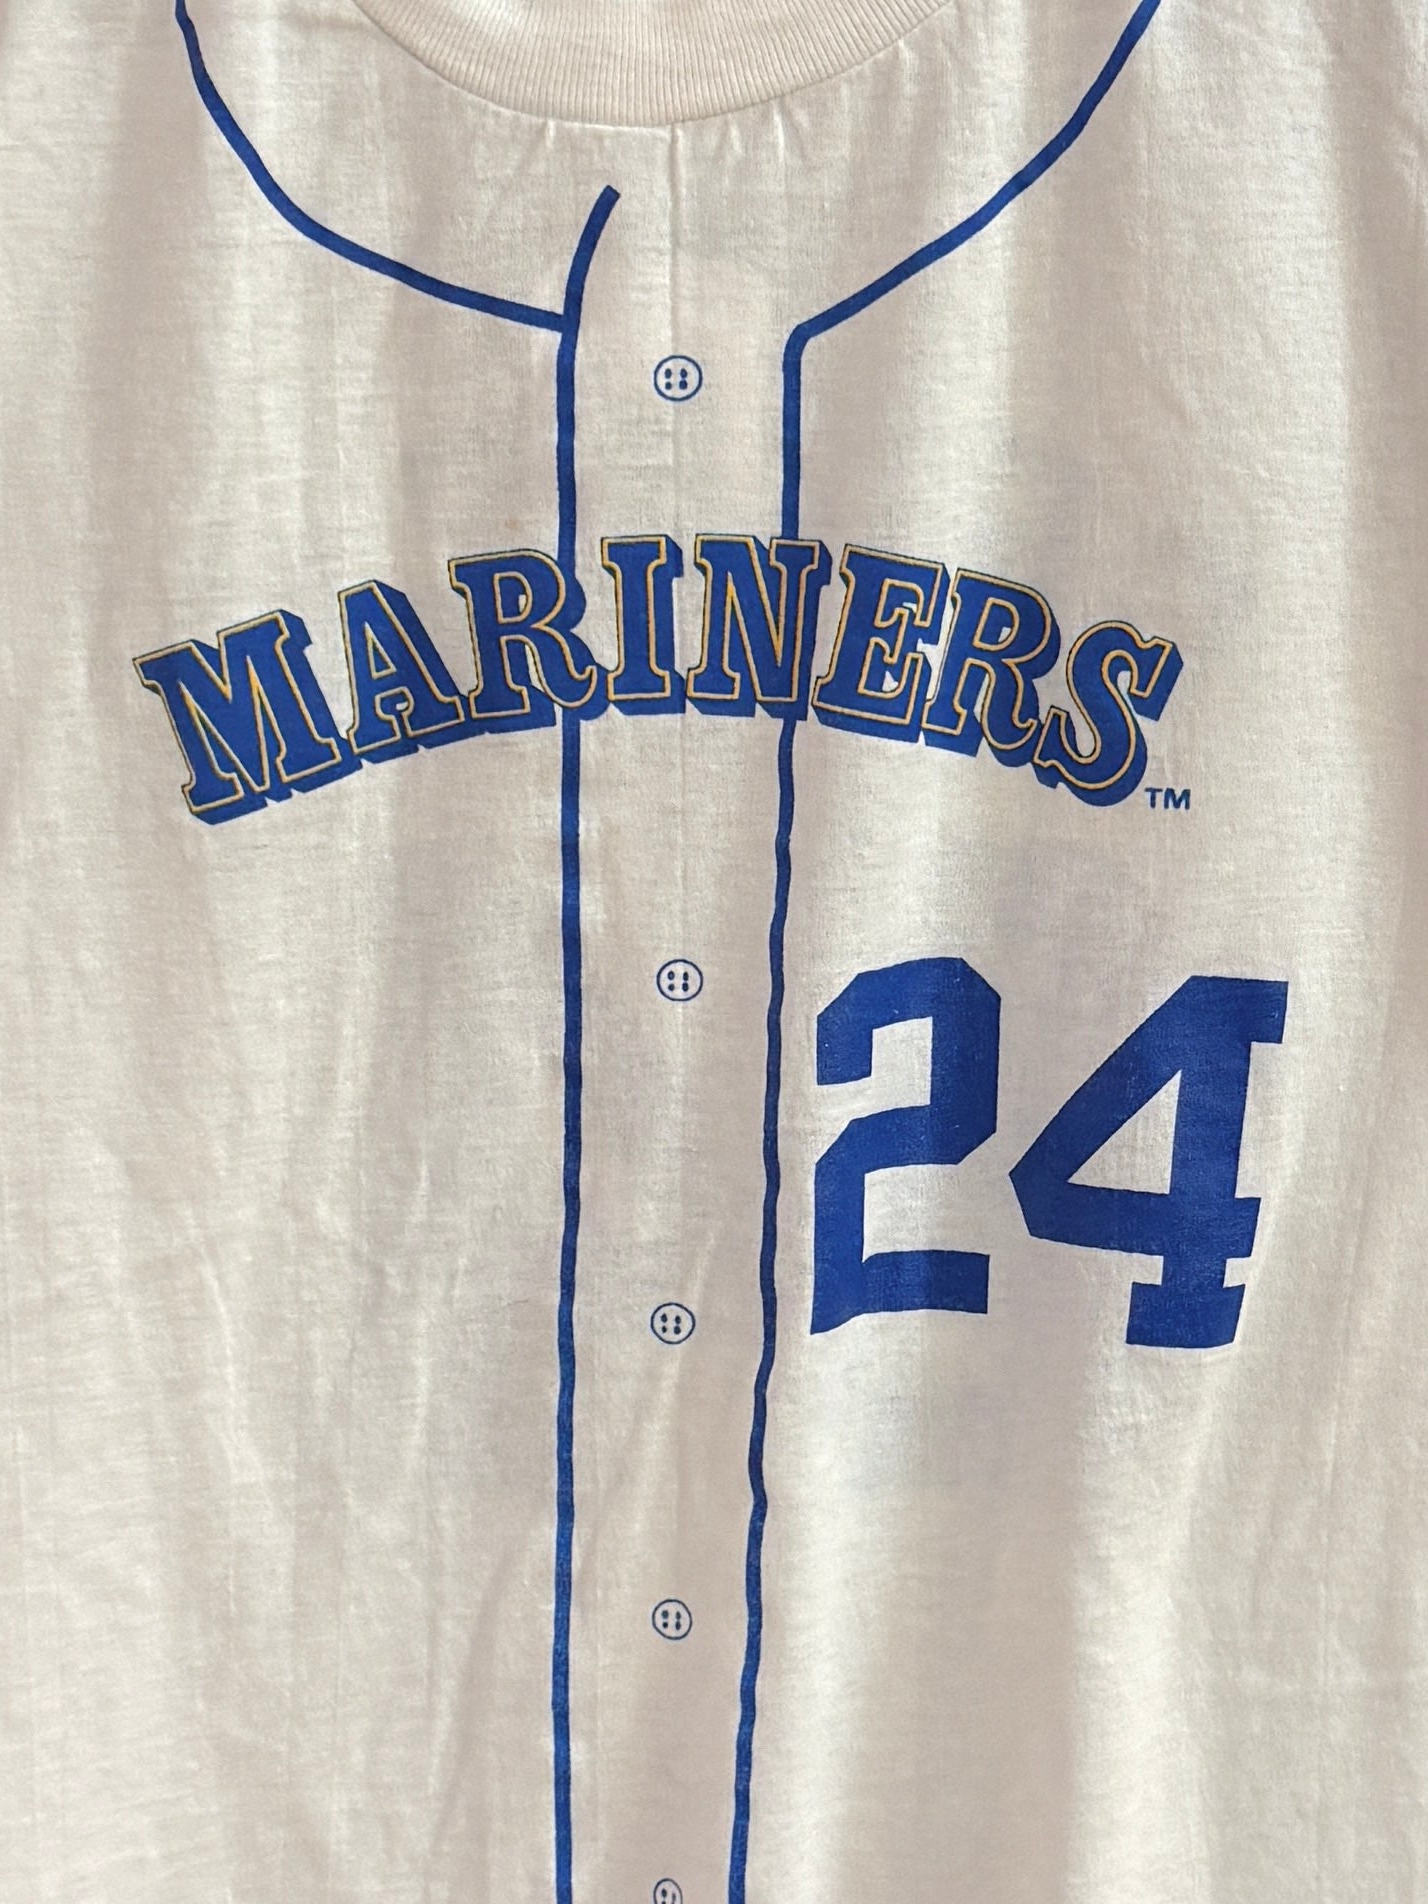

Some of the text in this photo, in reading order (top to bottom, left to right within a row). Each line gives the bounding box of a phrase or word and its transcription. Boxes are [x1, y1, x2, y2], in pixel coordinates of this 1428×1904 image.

[132, 534, 1192, 826] MARINERS TM
[809, 956, 1289, 1349] 24
